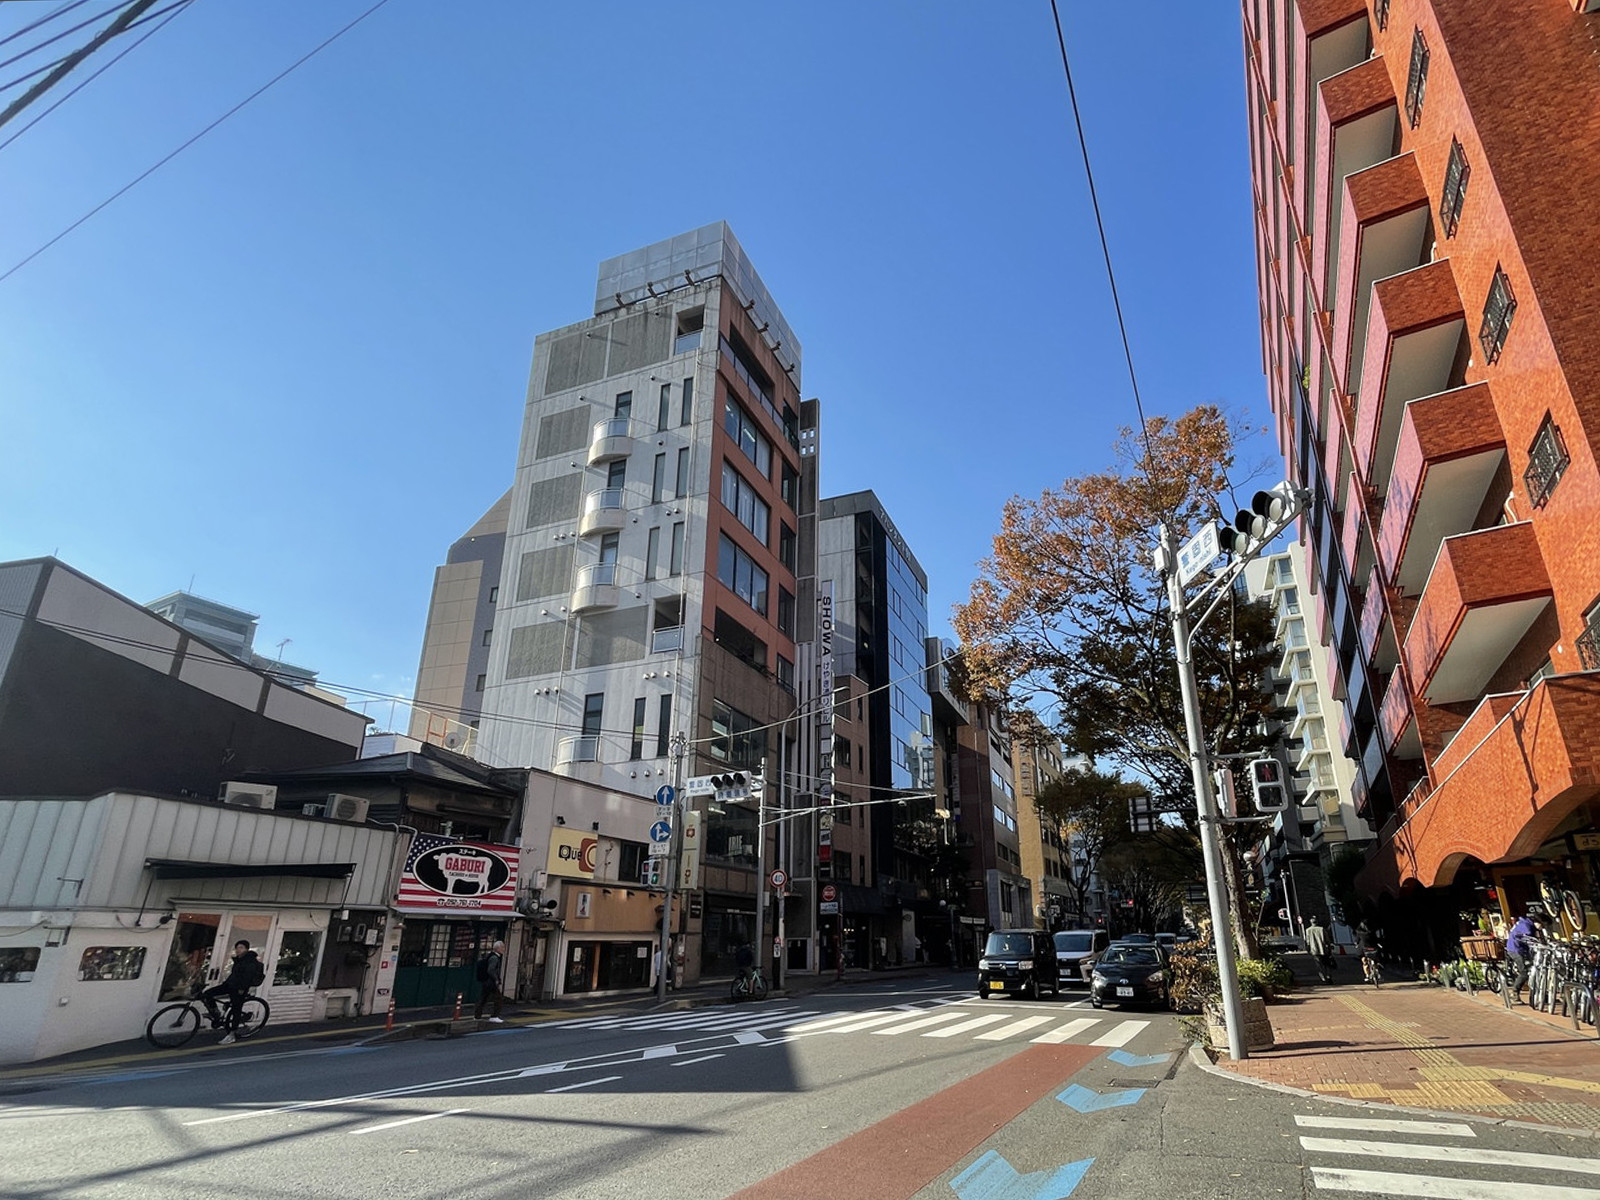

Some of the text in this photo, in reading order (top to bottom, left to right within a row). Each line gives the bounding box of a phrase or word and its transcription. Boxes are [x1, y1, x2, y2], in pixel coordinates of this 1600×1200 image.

[822, 596, 832, 656] SHOWA
[459, 848, 477, 856] ステーキ
[445, 857, 486, 874] GABURI
[774, 874, 783, 883] 40
